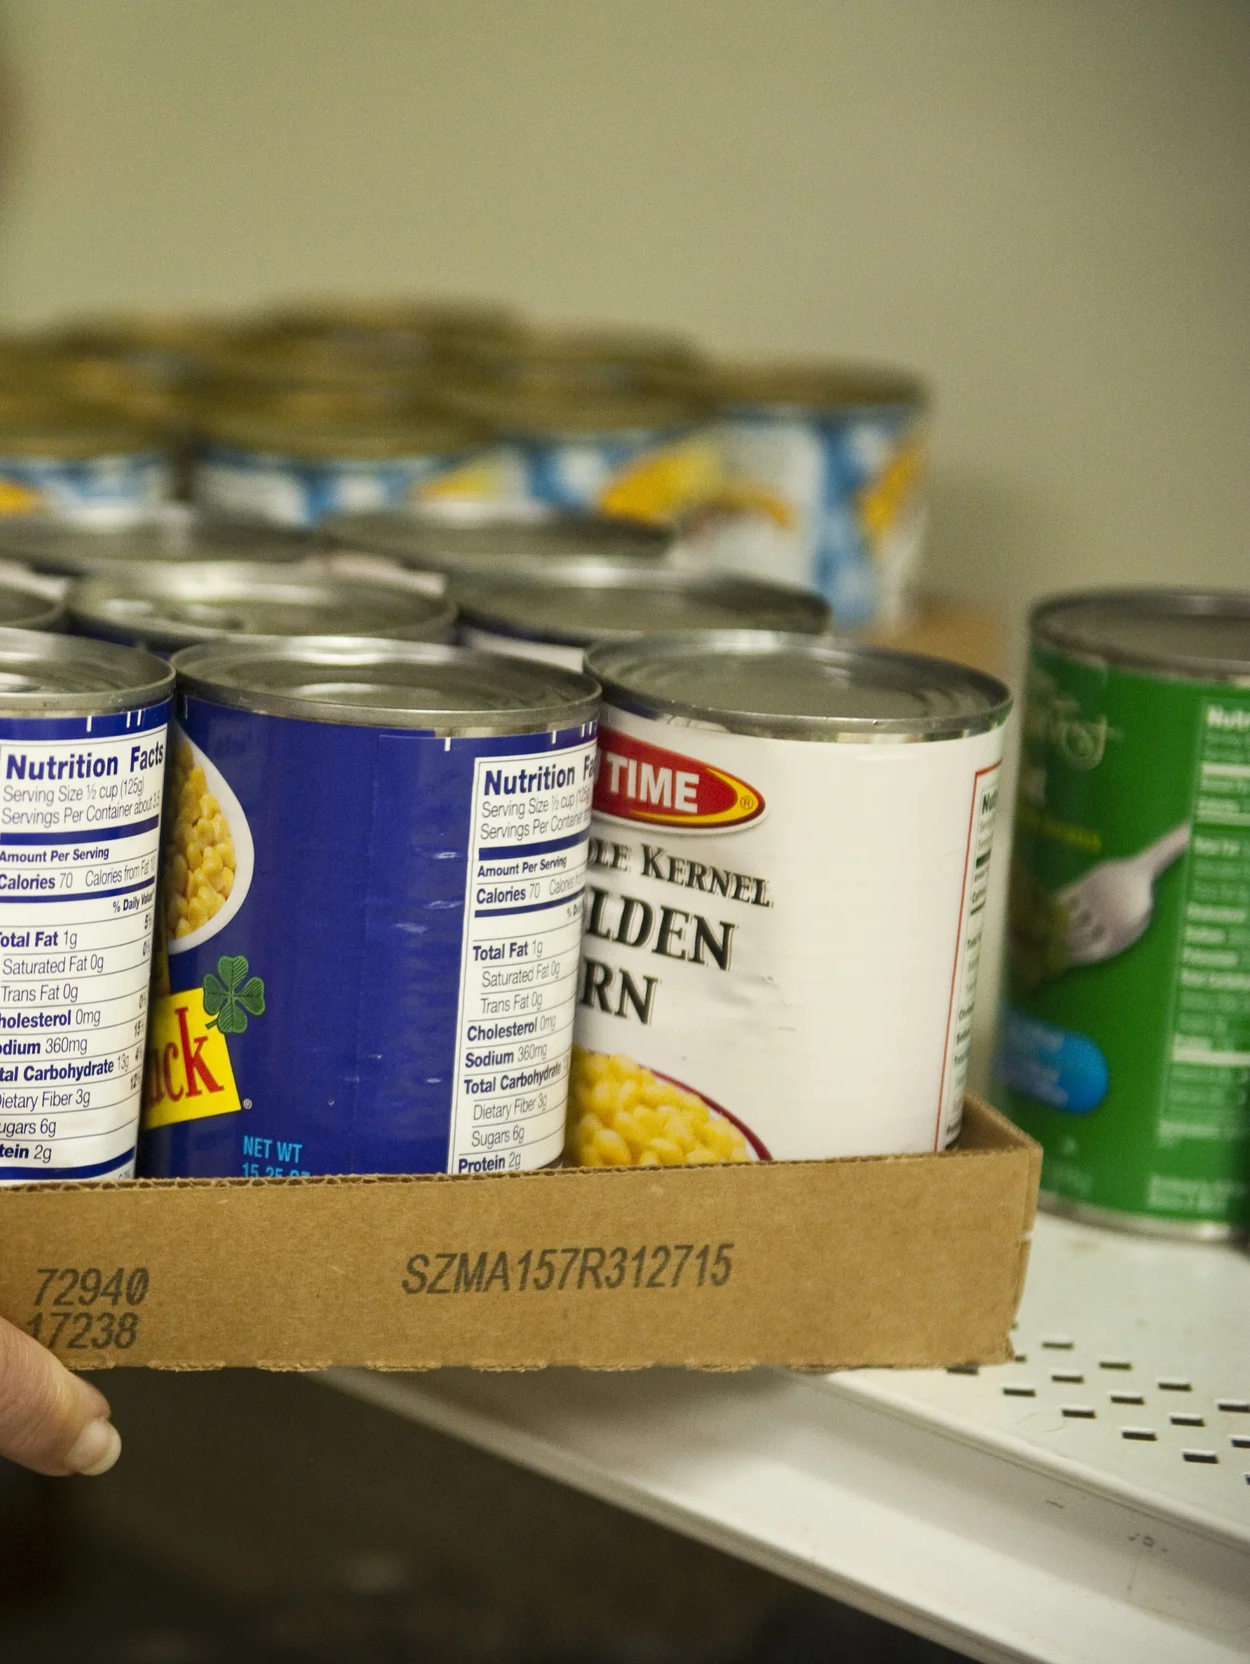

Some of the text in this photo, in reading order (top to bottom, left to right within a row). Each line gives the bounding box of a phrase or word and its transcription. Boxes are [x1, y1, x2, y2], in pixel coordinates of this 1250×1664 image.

[6, 741, 164, 780] Nutrition Facts
[483, 763, 576, 796] Nutrition
[606, 752, 700, 814] TIME
[3, 784, 60, 807] Serving
[58, 783, 83, 802] Size
[100, 781, 119, 800] cup
[481, 800, 526, 820] Serving
[528, 798, 549, 815] Size
[561, 793, 575, 811] cup
[2, 807, 60, 828] Servings
[63, 808, 83, 823] Per
[86, 802, 133, 822] Container
[134, 797, 152, 815] about
[480, 822, 530, 841] Servings
[532, 821, 550, 836] Per
[550, 812, 584, 832] Container
[51, 849, 69, 862] Per
[73, 847, 110, 862] Serving
[477, 856, 568, 878] Amount Per Serving
[59, 872, 73, 889] 70
[85, 866, 123, 888] Calories
[124, 864, 140, 882] from
[640, 843, 774, 909] KERNEL
[476, 886, 527, 904] Calories
[529, 882, 541, 899] 70
[549, 878, 574, 896] Calories
[113, 901, 121, 913] %
[123, 896, 141, 911] Daily
[34, 931, 59, 947] Fat
[63, 930, 78, 948] 1g
[472, 939, 544, 962] Total Fat 1g
[2, 954, 104, 976] Saturated Fat 0g
[482, 960, 561, 988] Saturated Fat 0g
[1, 983, 79, 1003] Trans Fat 0g
[481, 990, 543, 1014] Trans Fat 0g
[75, 1008, 101, 1027] 0mg
[467, 1017, 538, 1042] Cholesterol
[45, 1037, 88, 1055] 360mg
[465, 1049, 514, 1069] Sodium
[517, 1042, 548, 1063] 360mg
[23, 1058, 114, 1082] Carbohydrate
[464, 1076, 496, 1095] Total
[500, 1061, 562, 1091] Carbohydrate
[42, 1090, 73, 1108] Fiber
[75, 1088, 91, 1108] 3g
[473, 1092, 548, 1121] Dietary Fiber 3g
[40, 1117, 57, 1138] 6g
[471, 1124, 525, 1150] Sugars 6g
[34, 1143, 52, 1162] 2g
[243, 1134, 304, 1164] NET WT
[458, 1151, 522, 1174] Protein 2g
[400, 1242, 736, 1295] SZMA157R312715
[34, 1266, 150, 1307] 72940
[27, 1311, 140, 1350] 17238
